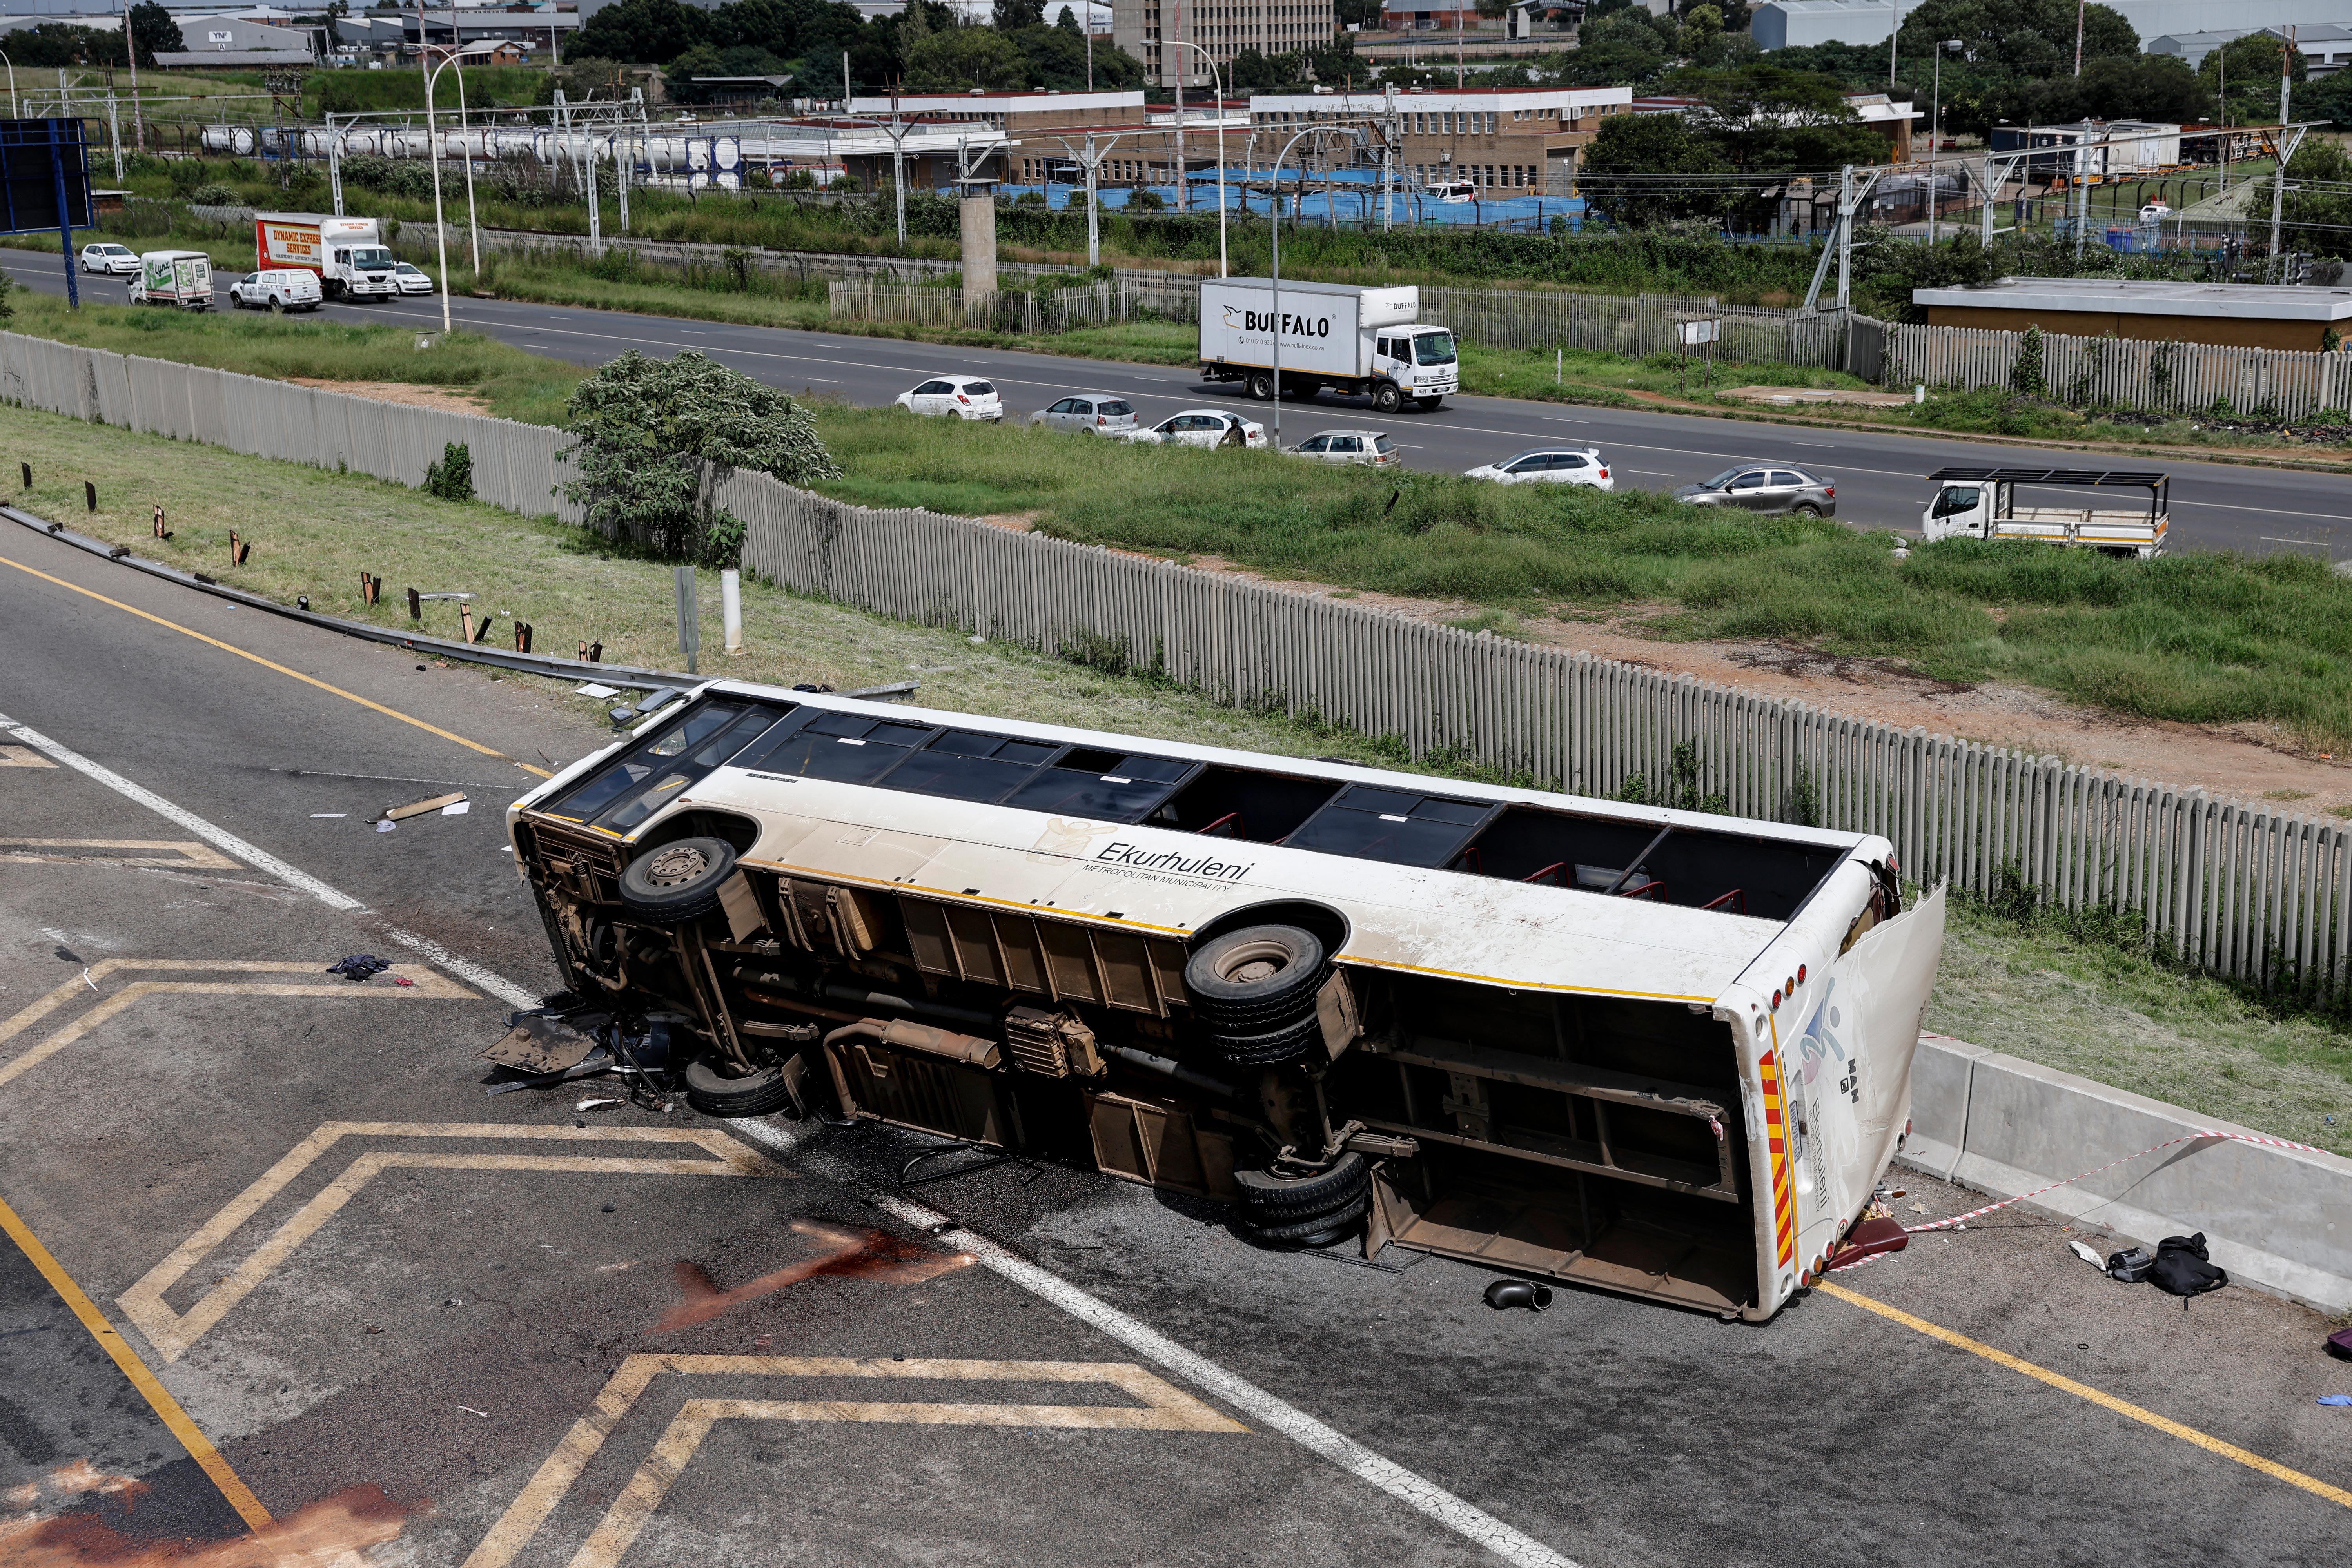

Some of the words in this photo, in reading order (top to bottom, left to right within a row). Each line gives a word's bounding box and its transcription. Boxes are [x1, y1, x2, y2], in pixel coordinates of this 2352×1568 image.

[273, 230, 299, 242] DYNAMIC
[299, 232, 321, 245] EXPRESS
[287, 243, 311, 255] SERVICES
[155, 261, 170, 277] Lynx
[1393, 301, 1416, 310] BUFFALO
[1245, 310, 1329, 338] BUFFALO
[1280, 343, 1324, 351] www.buffaloex.co.za
[1098, 842, 1255, 881] Ekurhuleni
[1083, 864, 1158, 882] METROPOLITAN
[1159, 876, 1230, 893] MUNICIPALITY
[1848, 1058, 1859, 1103] MAN
[1790, 1105, 1799, 1140] WNP298
[1808, 1109, 1817, 1165] METROPOLITAN
[1794, 1146, 1801, 1158] GP
[1813, 1096, 1829, 1209] Ekurhuleni
